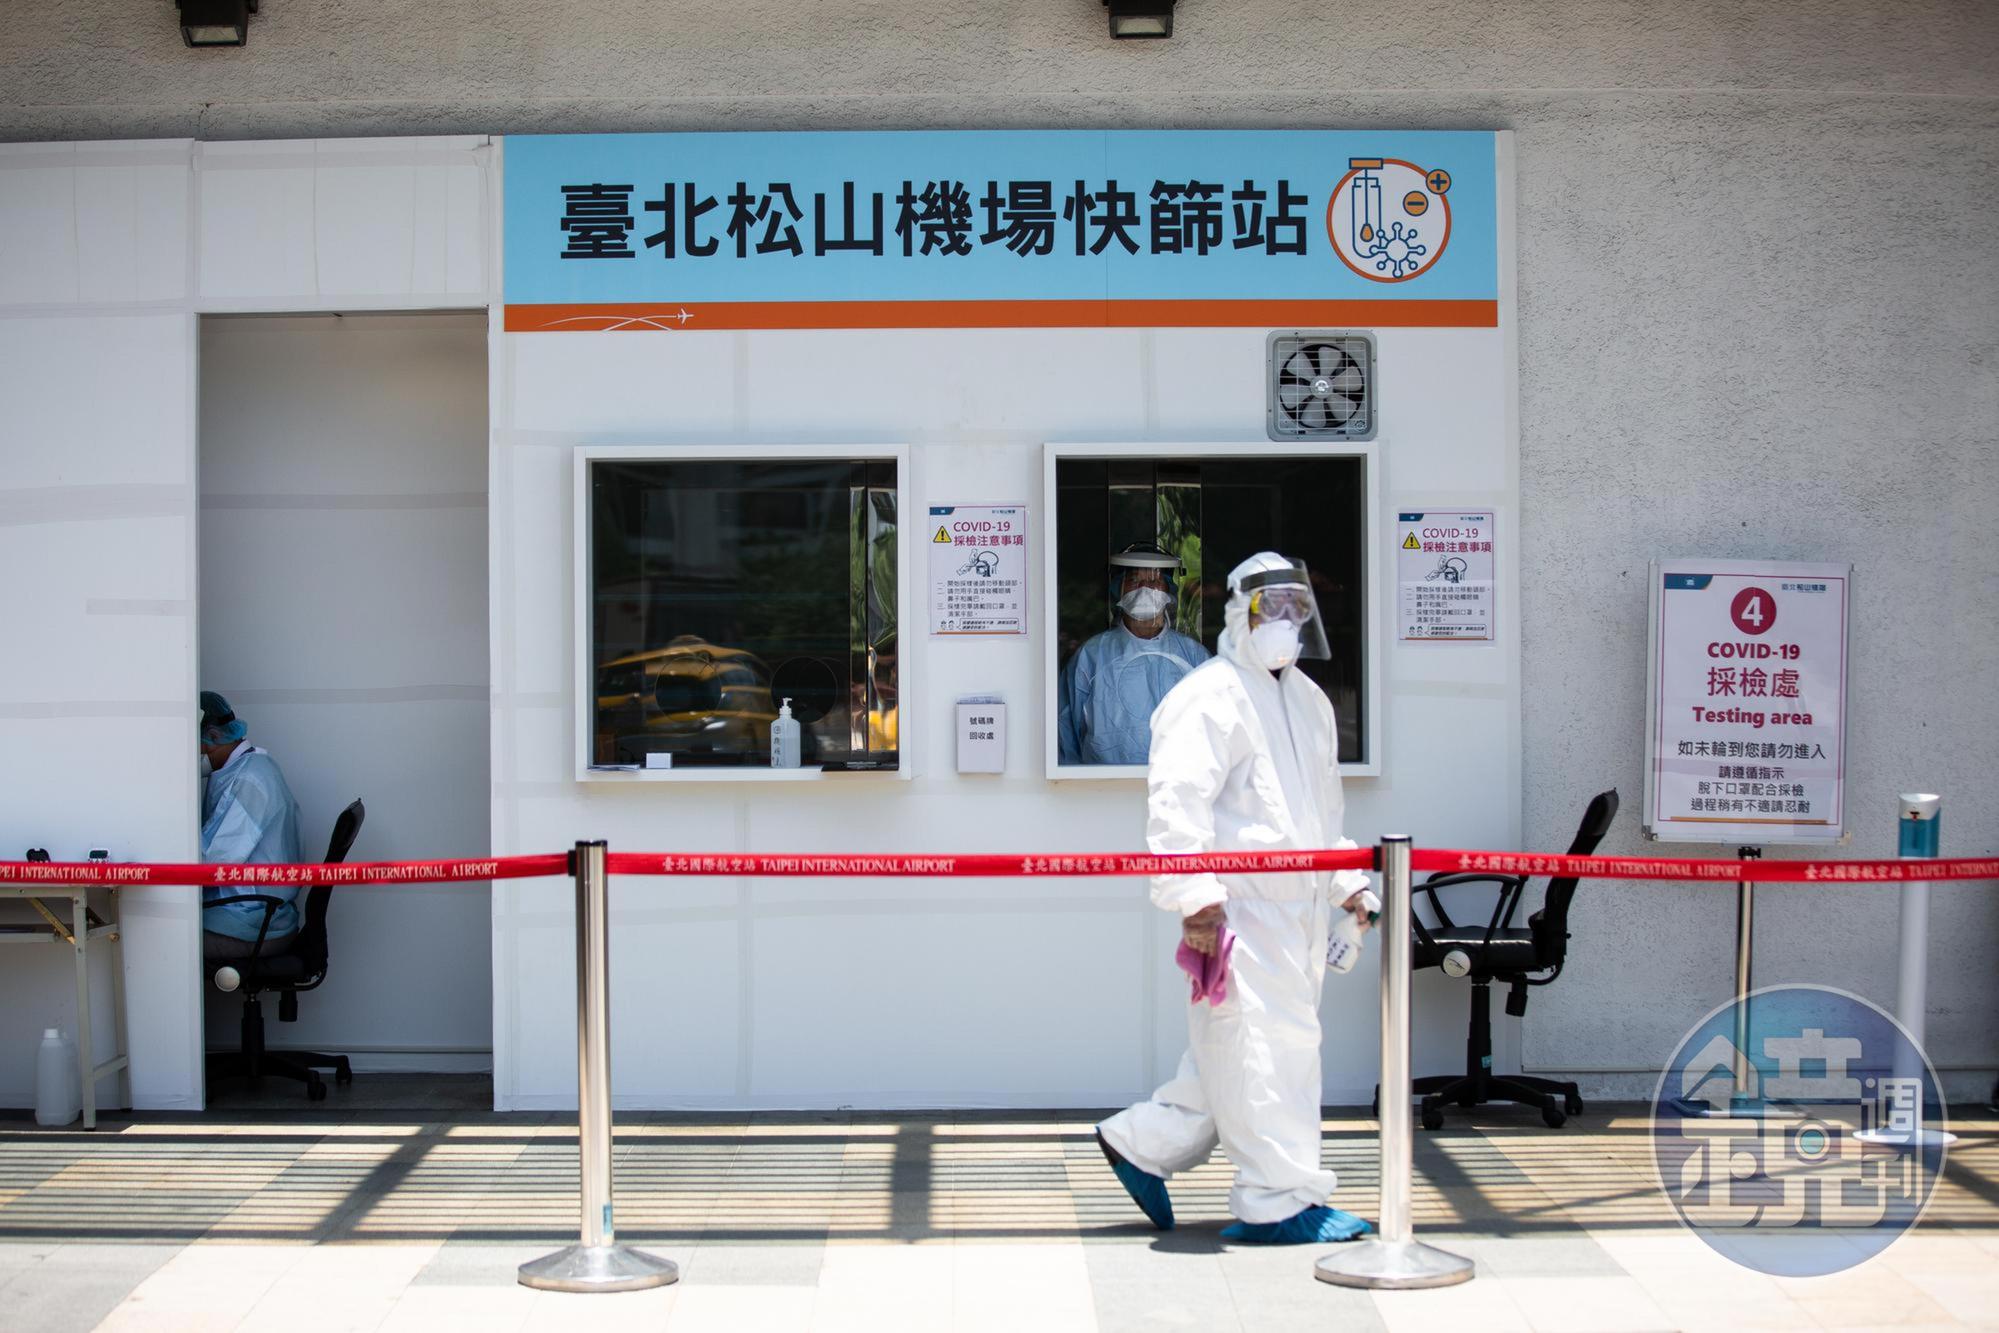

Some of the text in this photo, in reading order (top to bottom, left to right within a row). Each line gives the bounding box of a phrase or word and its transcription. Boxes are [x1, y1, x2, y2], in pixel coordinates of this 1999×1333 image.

[561, 179, 1309, 261] 臺北松山機場快篩站
[953, 521, 1011, 532] COVID-19
[1422, 527, 1479, 539] COVID-19
[953, 535, 1024, 547] 採檢注意事項
[1423, 541, 1492, 553] 採檢注意事項
[1741, 596, 1764, 627] 4
[1707, 642, 1801, 660] COVID-19
[1707, 666, 1800, 698] 採檢處
[1692, 706, 1813, 727] Testing area
[969, 731, 994, 740] 回收處
[1678, 740, 1827, 760] 如未輪到您請勿進入
[1718, 765, 1785, 780] 請遵循指示
[1698, 781, 1804, 796] 脫下口罩配合採檢
[1690, 798, 1810, 814] 過程稍有不適請忍耐
[214, 862, 498, 882] 臺北國際航空站 TAIPEI INTERNATIONAL AIRPORT
[662, 856, 955, 873] 臺北國際航空站 TAIPEI INTERNATIONAL AIRPORT
[1021, 855, 1314, 873] 臺北國際航空站 TAIPEI INTERNATIONAL AIRPORT
[1567, 859, 1606, 874] TAIPEI
[1609, 861, 1693, 877] INTERNATIONAL
[1696, 863, 1742, 878] AIRPORT
[20, 866, 101, 880] INTERNATIONAL
[105, 867, 150, 880] AIRPORT
